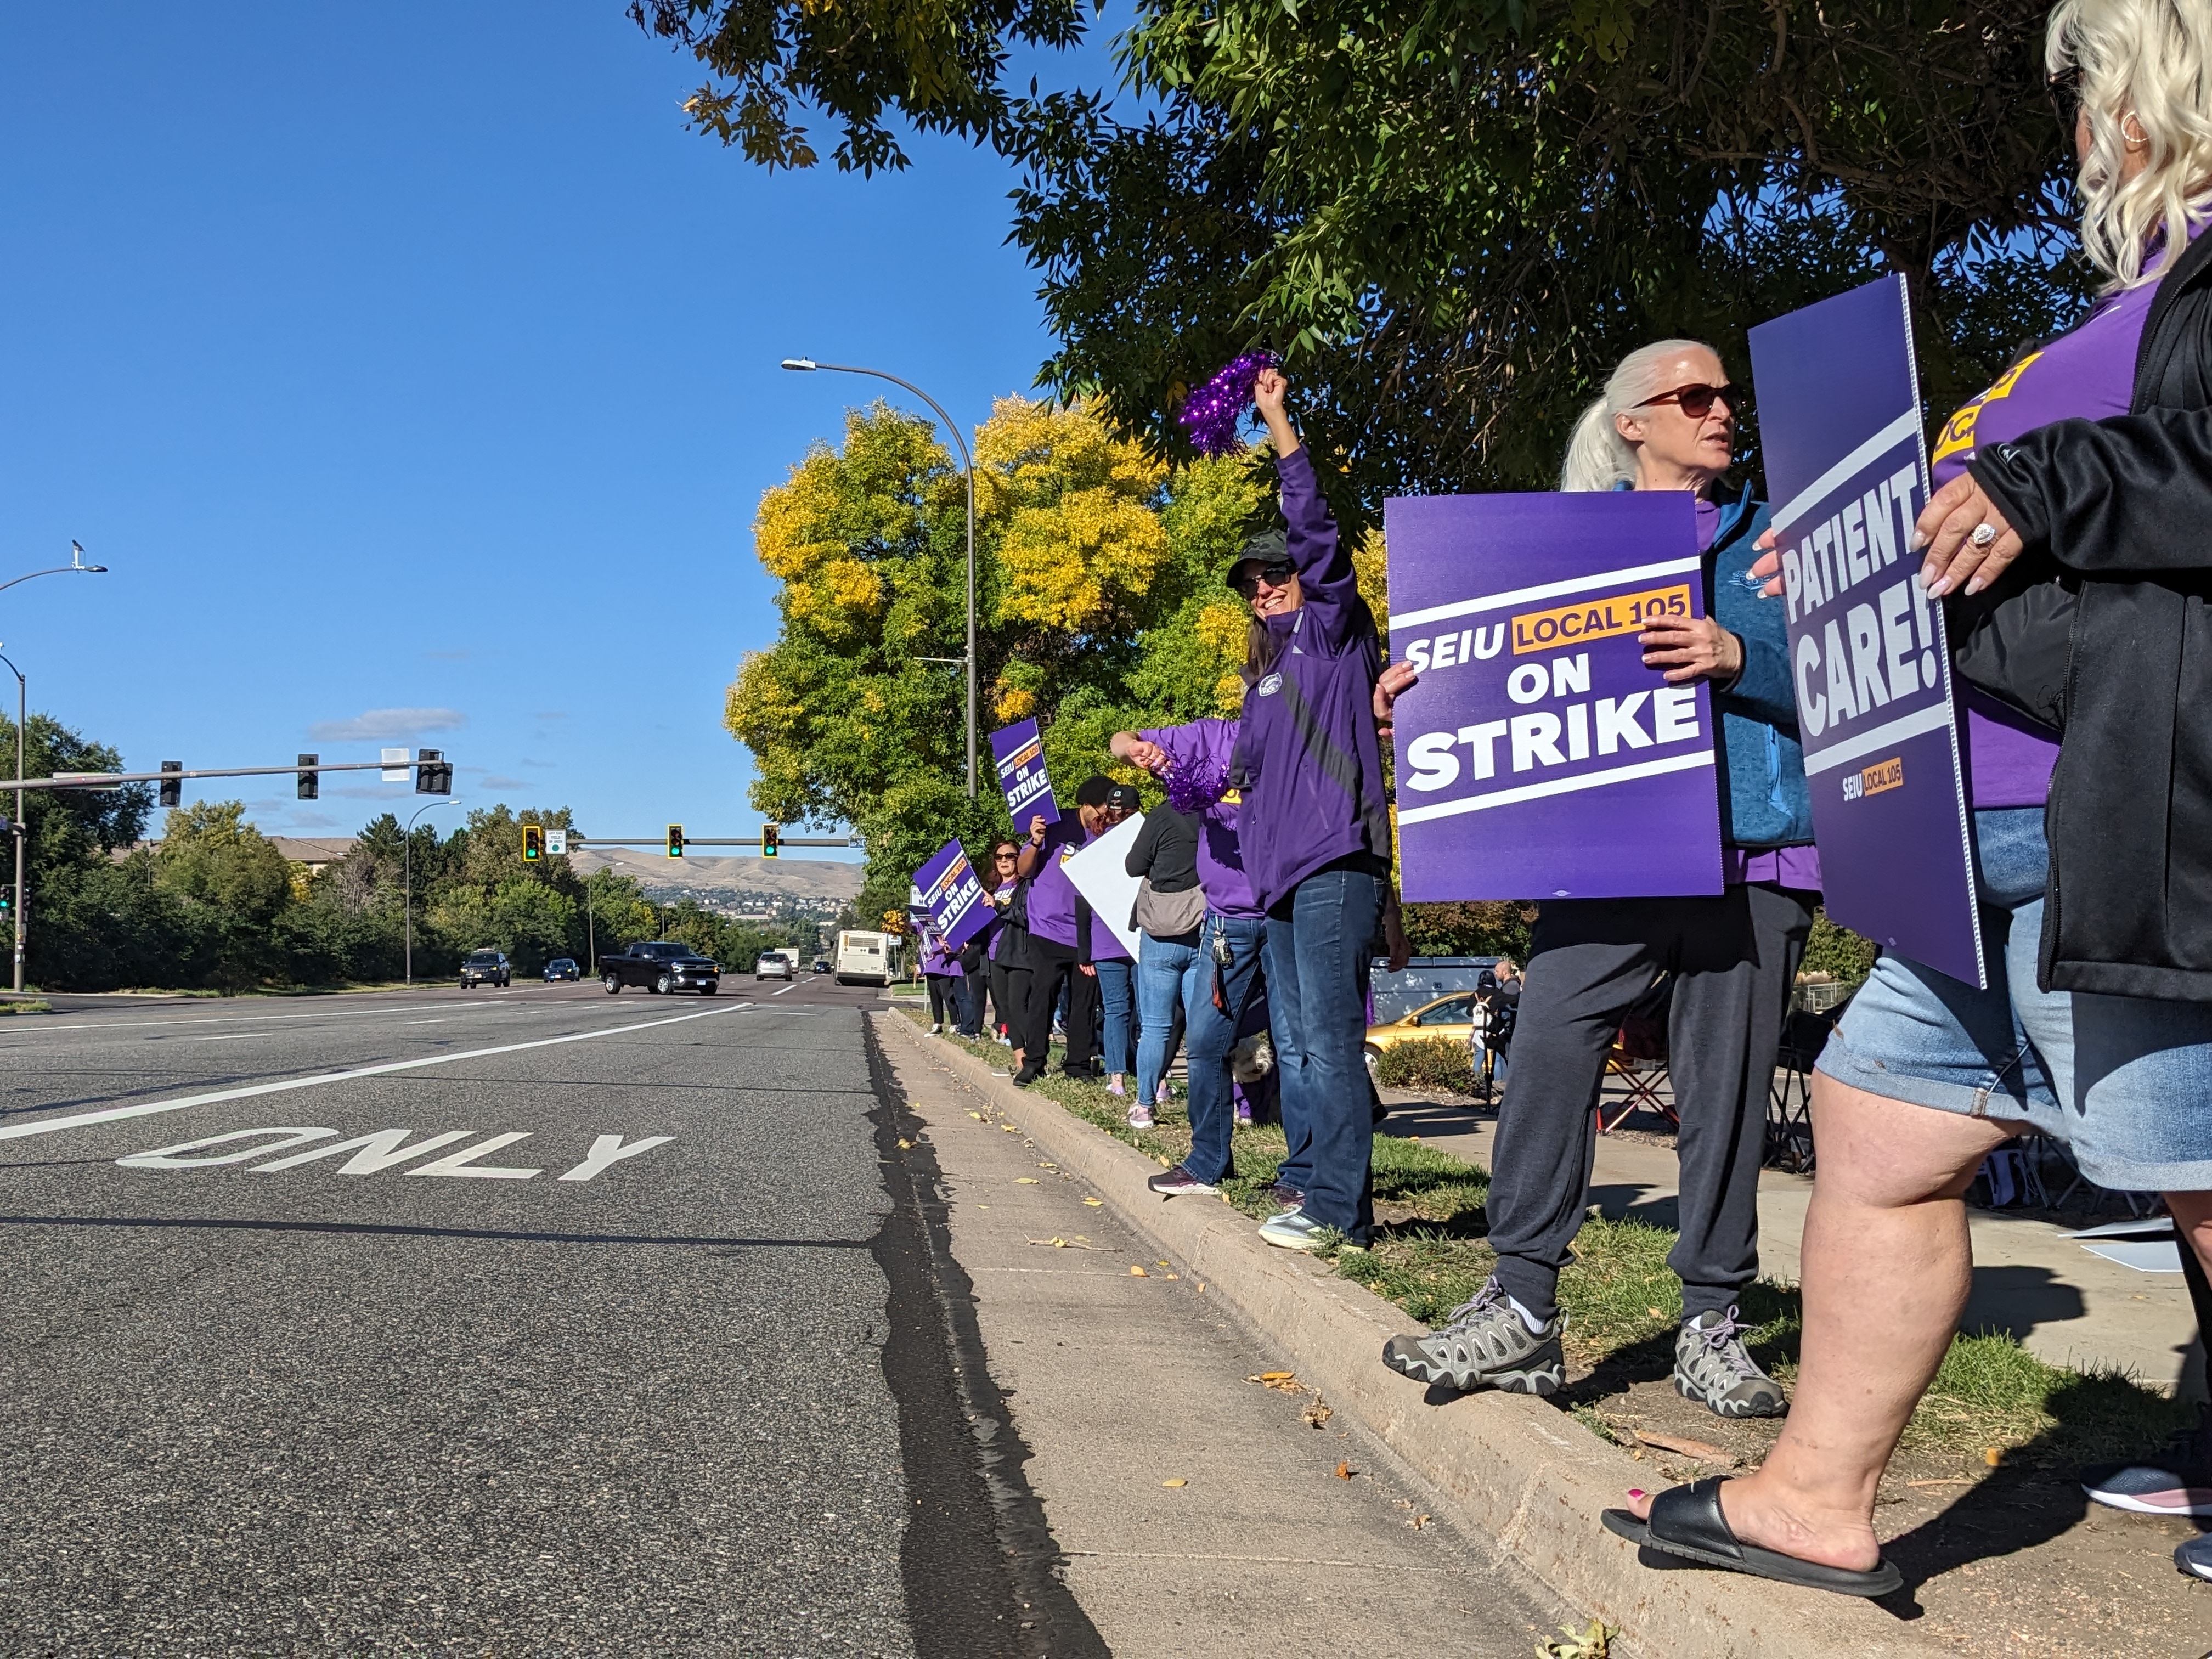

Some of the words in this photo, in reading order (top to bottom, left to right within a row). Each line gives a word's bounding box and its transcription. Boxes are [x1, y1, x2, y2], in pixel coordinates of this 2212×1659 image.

[1782, 461, 1917, 624] PATIENT
[1405, 624, 1504, 674] SEIU
[1517, 607, 1621, 646] LOCAL
[1630, 594, 1686, 624] 105
[1797, 573, 1937, 737] CARE!
[1507, 653, 1590, 704] ON
[1000, 761, 1014, 778] SEIU
[1015, 752, 1029, 766] LOCAL
[1030, 746, 1039, 756] 105
[1406, 687, 1700, 792] STRIKE
[1007, 768, 1047, 807] STRIKE
[1016, 765, 1029, 782] ON
[1843, 773, 1863, 801] SEIU
[1864, 769, 1887, 791] LOCAL
[1887, 764, 1901, 783] 105
[927, 886, 943, 908] SEIU
[942, 871, 957, 889] LOCAL
[956, 860, 965, 872] 105
[938, 876, 978, 930] STRIKE
[945, 883, 958, 901] ON
[115, 1127, 677, 1181] ONLY
